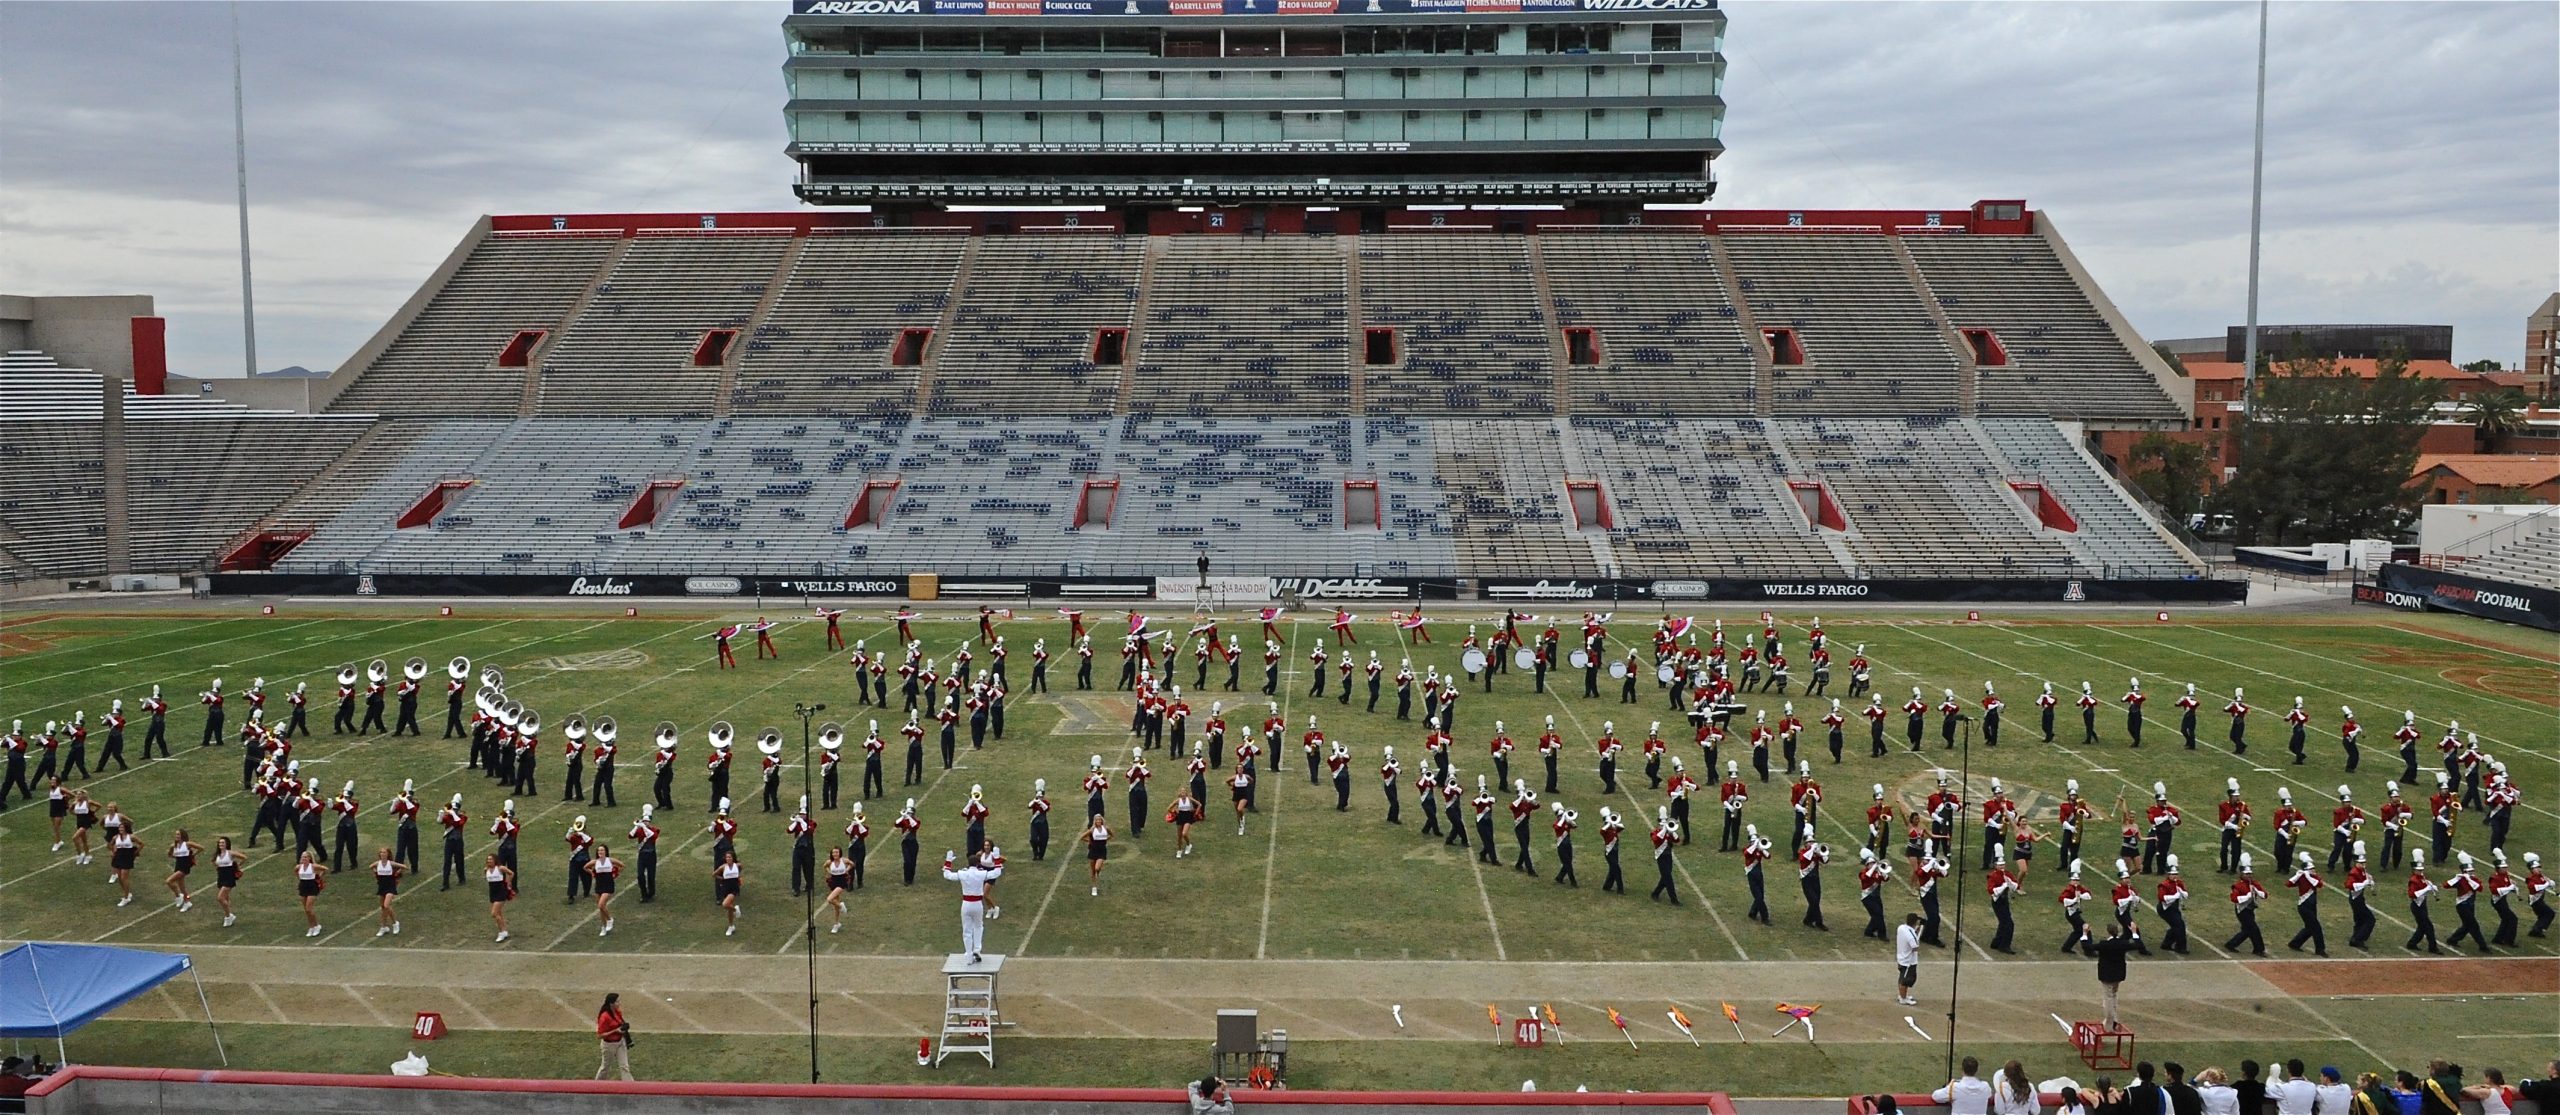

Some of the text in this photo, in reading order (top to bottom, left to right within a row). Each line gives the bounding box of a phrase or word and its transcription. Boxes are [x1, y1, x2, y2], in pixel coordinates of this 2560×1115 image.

[806, 1, 920, 13] ARIZONA
[935, 1, 943, 9] 22
[1584, 0, 1708, 9] WILDCATS
[554, 221, 565, 230] 17
[703, 220, 714, 229] 18
[873, 219, 884, 227] 19
[1065, 218, 1078, 227] 20
[1211, 217, 1223, 226] 21
[1432, 217, 1445, 226] 22
[1629, 217, 1641, 225] 23
[1789, 217, 1802, 226] 24
[1927, 218, 1940, 226] 25
[202, 383, 212, 391] 16
[569, 577, 633, 595] Bashas'
[794, 581, 896, 592] WELLS FARGO
[1159, 584, 1193, 593] UNIVERSITY
[1235, 584, 1253, 593] BAND
[1254, 584, 1267, 593] DAY
[1763, 585, 1868, 595] WELLS FARGO
[2385, 592, 2421, 608] DOWN
[2474, 590, 2531, 612] FOOTBALL
[416, 1016, 433, 1036] 40
[1519, 1024, 1537, 1042] 40
